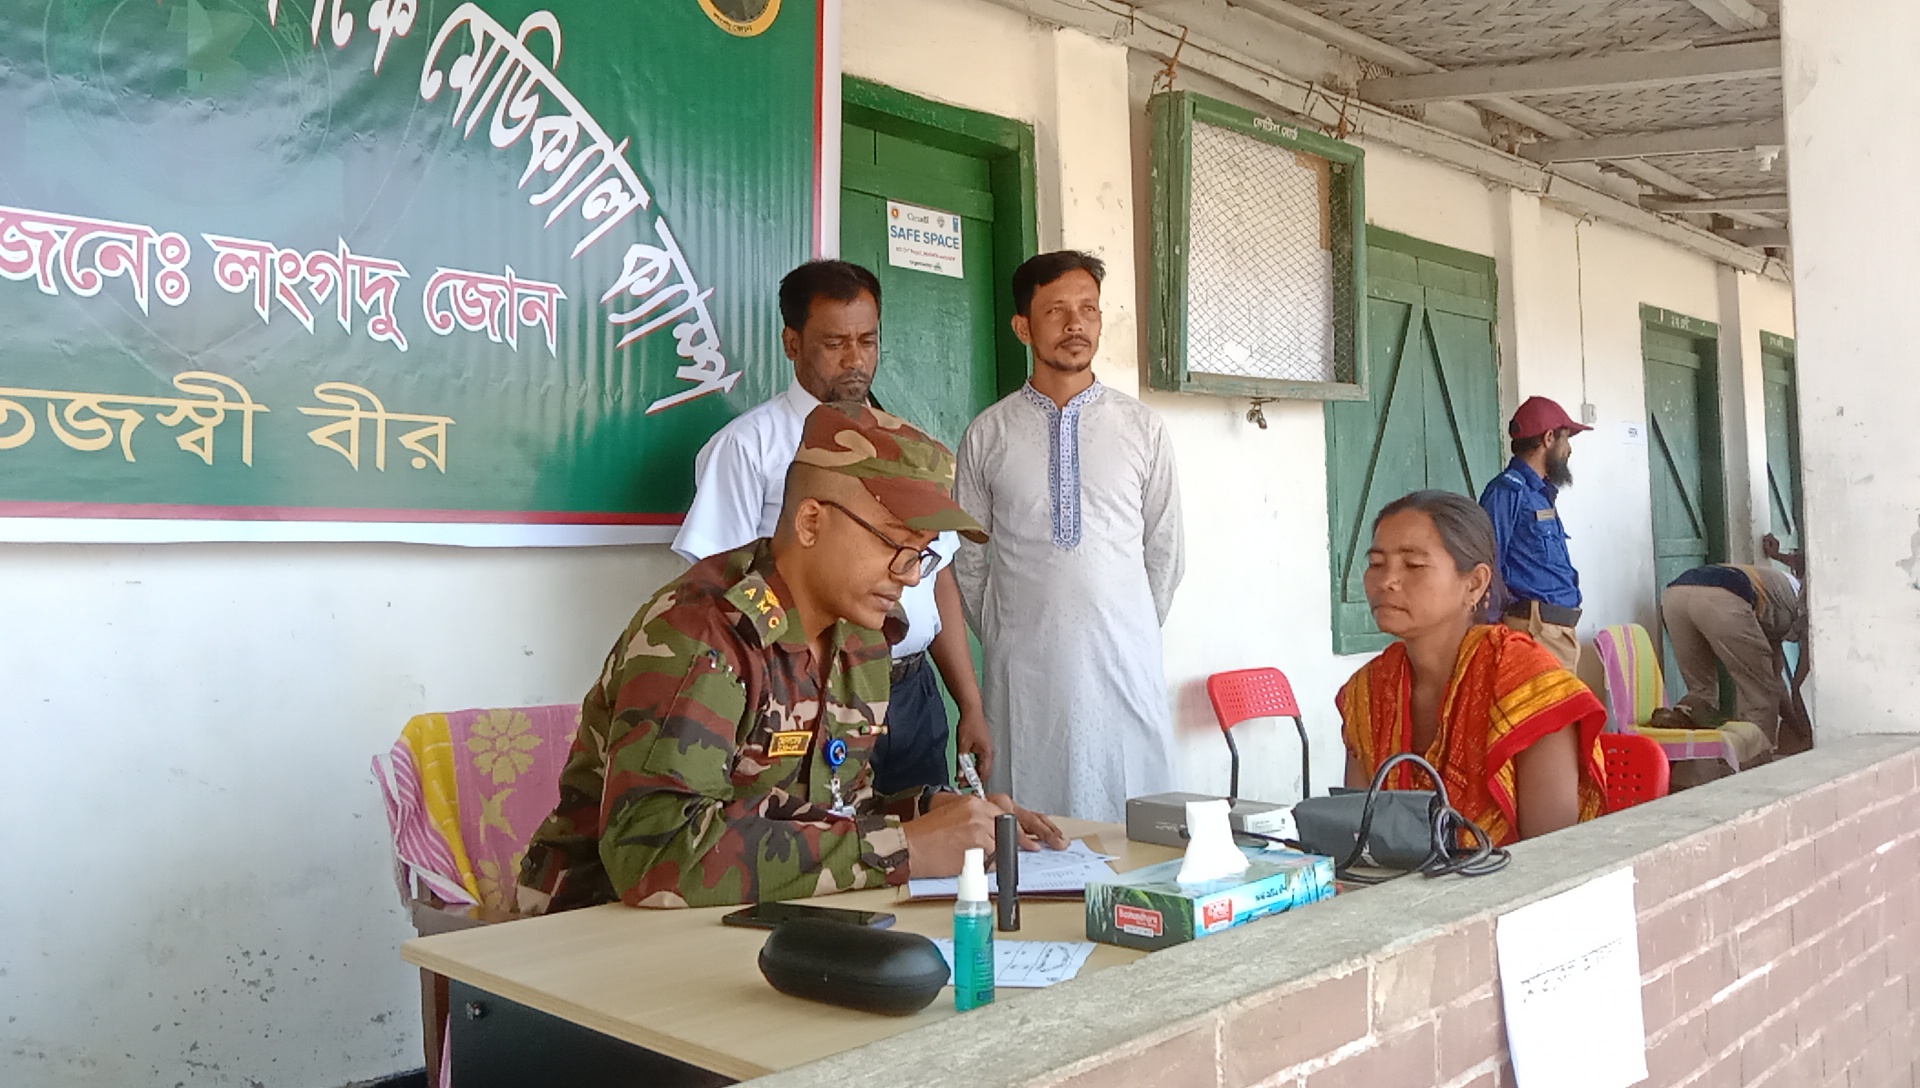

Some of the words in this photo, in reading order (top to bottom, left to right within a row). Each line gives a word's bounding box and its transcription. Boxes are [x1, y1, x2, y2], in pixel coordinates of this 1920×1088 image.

[421, 2, 651, 259] মেডিক্যাল
[601, 215, 744, 415] ক্যাম্প
[890, 225, 921, 243] SAFE
[923, 232, 960, 250] SPACE
[201, 232, 411, 351] লংগদু
[423, 264, 568, 359] জোন
[296, 381, 456, 474] বীর
